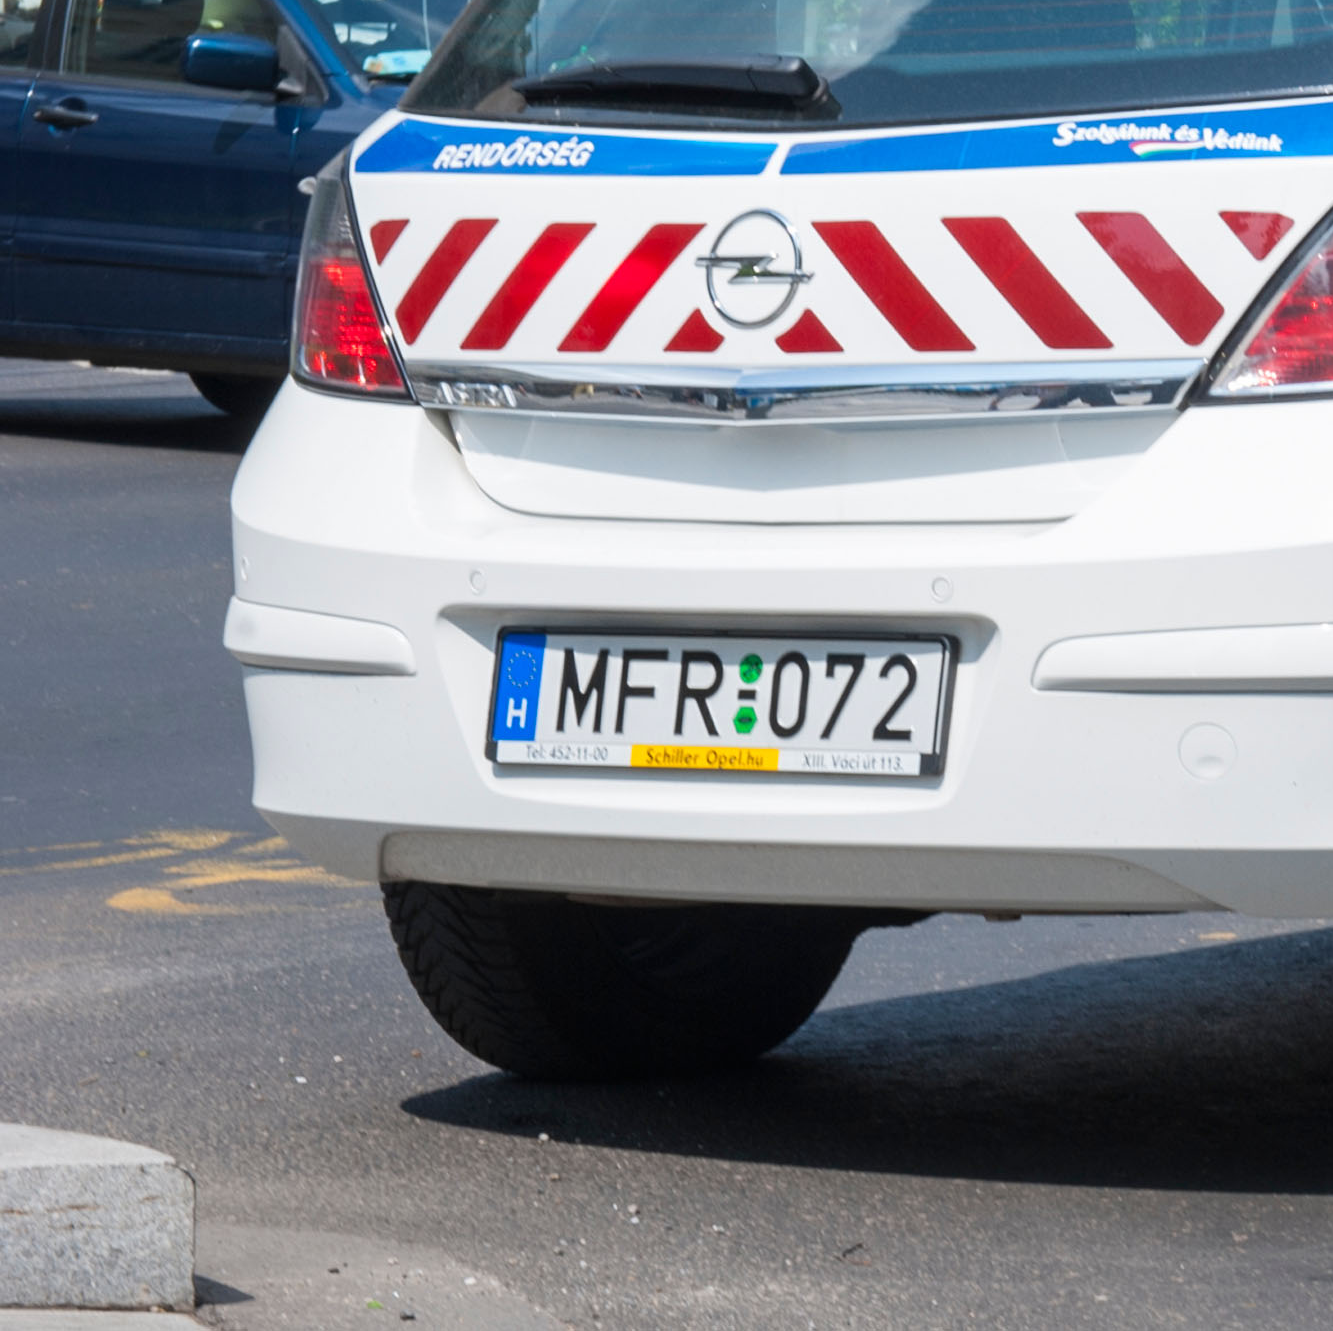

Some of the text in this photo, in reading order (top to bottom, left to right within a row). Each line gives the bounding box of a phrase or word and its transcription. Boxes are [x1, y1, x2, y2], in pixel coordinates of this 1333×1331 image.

[432, 136, 595, 169] RENDŐRSÉG
[505, 698, 528, 729] H
[549, 745, 609, 761] 452-11-00
[645, 748, 764, 768] Schiller Opel.hu
